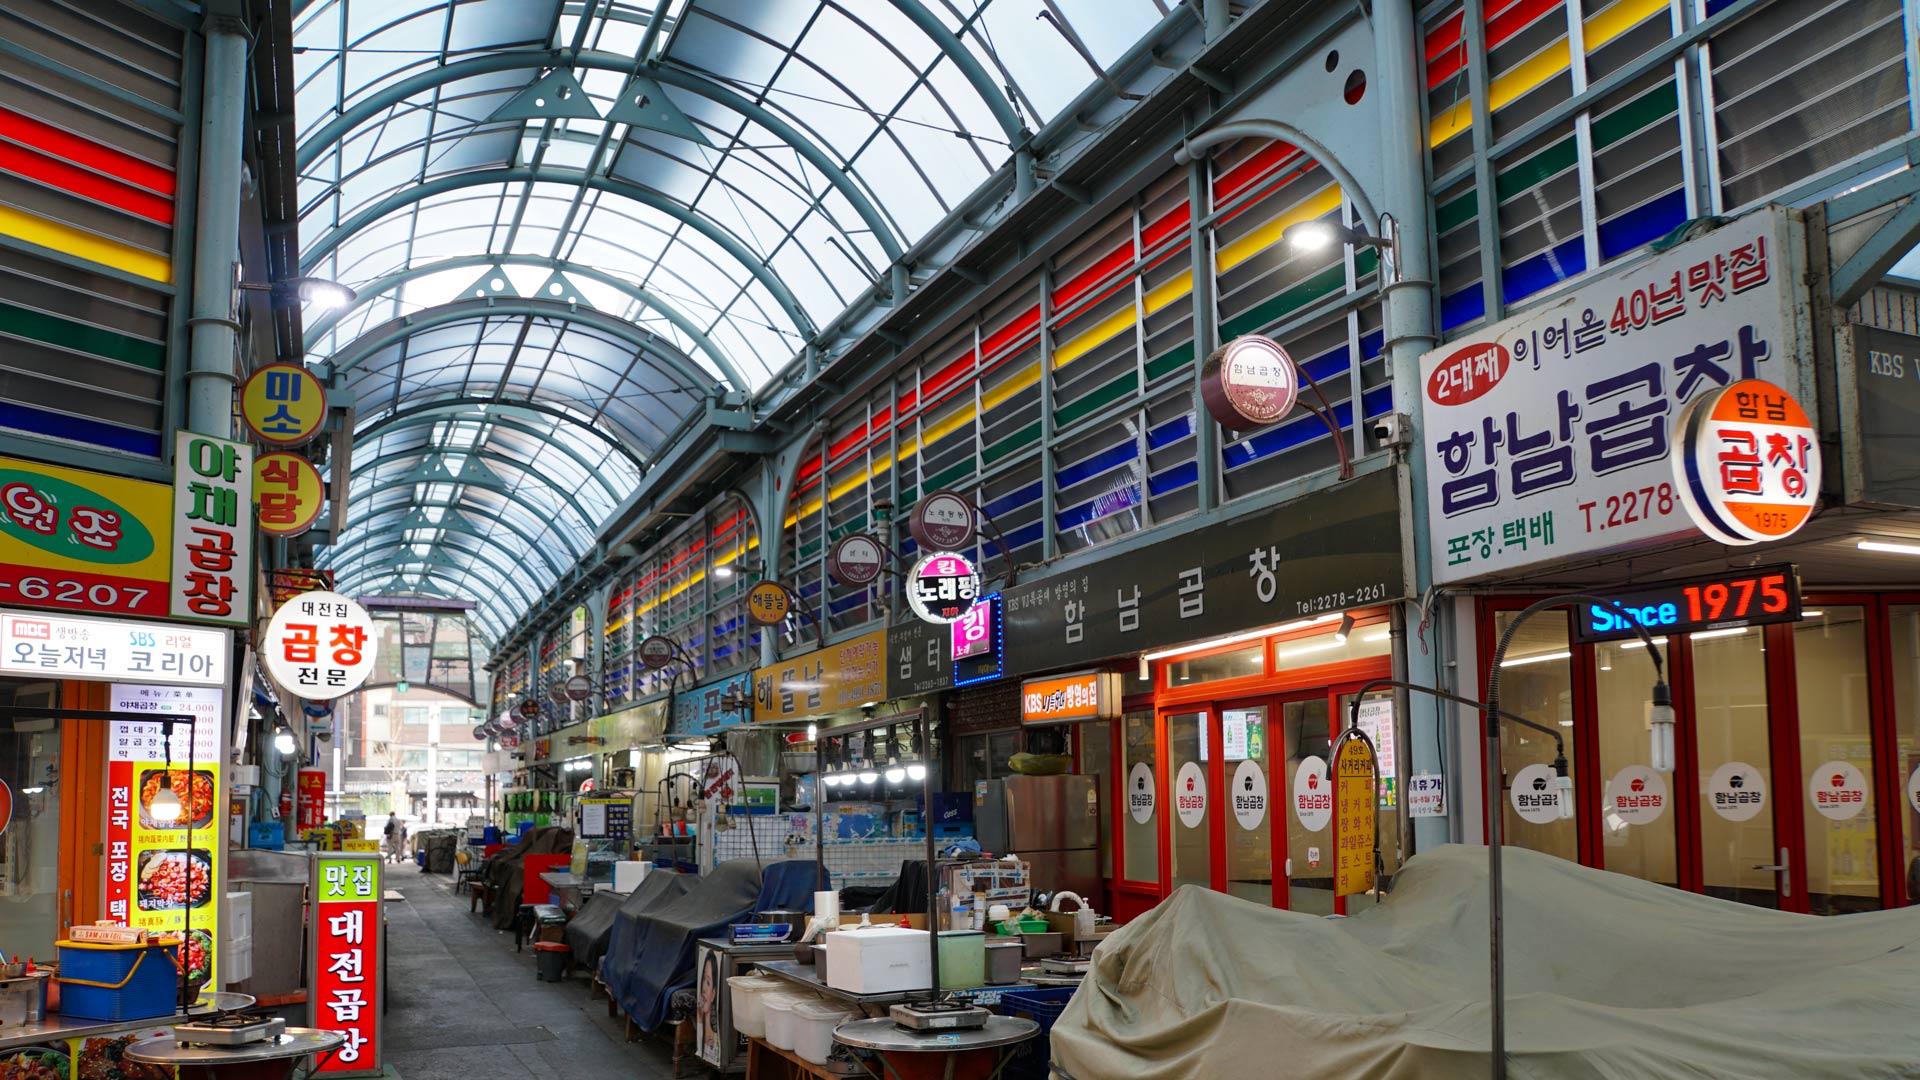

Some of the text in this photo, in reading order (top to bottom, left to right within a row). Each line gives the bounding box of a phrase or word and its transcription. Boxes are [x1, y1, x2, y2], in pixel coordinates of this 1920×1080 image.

[1437, 350, 1500, 400] 2대째
[1513, 309, 1606, 369] 이어온
[1869, 351, 1904, 378] KBS
[1234, 364, 1281, 377] 함남곱창
[264, 372, 301, 435] 미소
[1736, 391, 1787, 421] 함남
[1716, 429, 1812, 498] 곱창
[260, 460, 302, 524] 식당
[1, 483, 122, 551] 원조
[1755, 513, 1788, 528] 1975
[937, 560, 957, 574] 킹
[753, 592, 785, 610] 해뜰날
[918, 576, 977, 601] 노래팡
[1008, 599, 1019, 612] KBS
[1082, 576, 1089, 593] 집
[1065, 545, 1281, 645] 함남곱창
[1296, 581, 1387, 615] Tel:2278-2261
[301, 601, 348, 618] 대전집
[1591, 573, 1789, 632] Since 1975
[13, 621, 91, 641] MBC 생방송
[962, 608, 986, 642] 킹
[129, 631, 192, 648] SBS 리얼
[281, 623, 369, 666] 곱창
[11, 642, 107, 670] 오늘저녁
[127, 651, 214, 677] 코리아
[298, 666, 348, 687] 전문
[757, 660, 824, 714] 해뜰날
[119, 701, 158, 711] 야채곱창
[1024, 693, 1042, 713] KBS
[111, 786, 130, 830] 전국
[1179, 795, 1204, 809] 함남곱창
[1236, 795, 1264, 810] 함남곱창
[1299, 794, 1331, 810] 함남곱창
[1616, 795, 1663, 807] 함남곱창
[1715, 792, 1761, 804] 함남곱창
[1817, 790, 1863, 803] 함남곱창
[325, 864, 374, 897] 맛집
[327, 909, 369, 1064] 대전곱창
